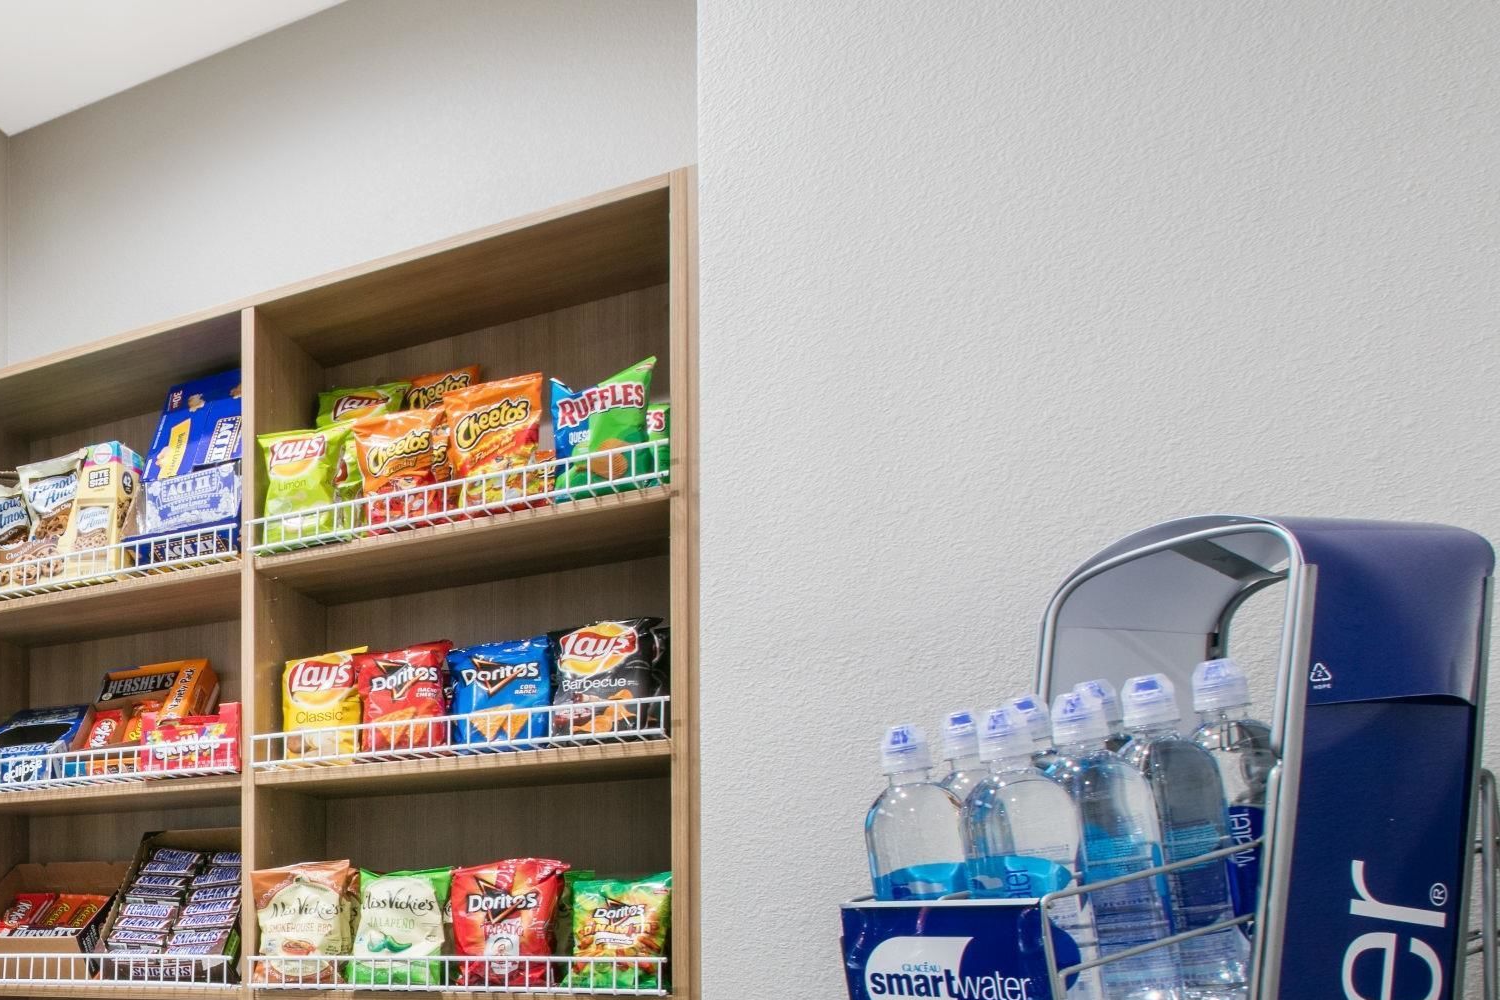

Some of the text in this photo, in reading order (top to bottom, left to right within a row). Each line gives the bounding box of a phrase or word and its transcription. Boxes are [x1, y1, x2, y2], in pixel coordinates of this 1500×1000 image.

[408, 375, 471, 409] Cheetos
[560, 384, 644, 428] RUFFLES
[456, 398, 529, 451] Cheetos
[369, 430, 431, 476] Cheetos
[89, 470, 109, 480] BITE
[89, 479, 109, 489] SIZE
[168, 475, 211, 496] ACT II
[108, 672, 176, 694] HERSHEY'S
[292, 663, 352, 692] Lay's
[371, 667, 438, 692] Doritos
[462, 662, 539, 686] Doritos
[169, 666, 196, 711] Variety Pack
[562, 678, 627, 692] Barbecue
[296, 710, 344, 724] Classic
[3, 760, 42, 783] eclipse
[194, 887, 239, 900] SNARKY
[387, 888, 435, 916] Vickie's
[468, 891, 537, 915] Doritos
[186, 901, 230, 913] COMICAL
[594, 904, 645, 918] Doritos
[173, 931, 221, 944] SNICKERS
[268, 923, 333, 933] SMOKEHOUSE BBQ
[133, 966, 191, 977] SNICKERS
[902, 962, 941, 973] GLACÉAU
